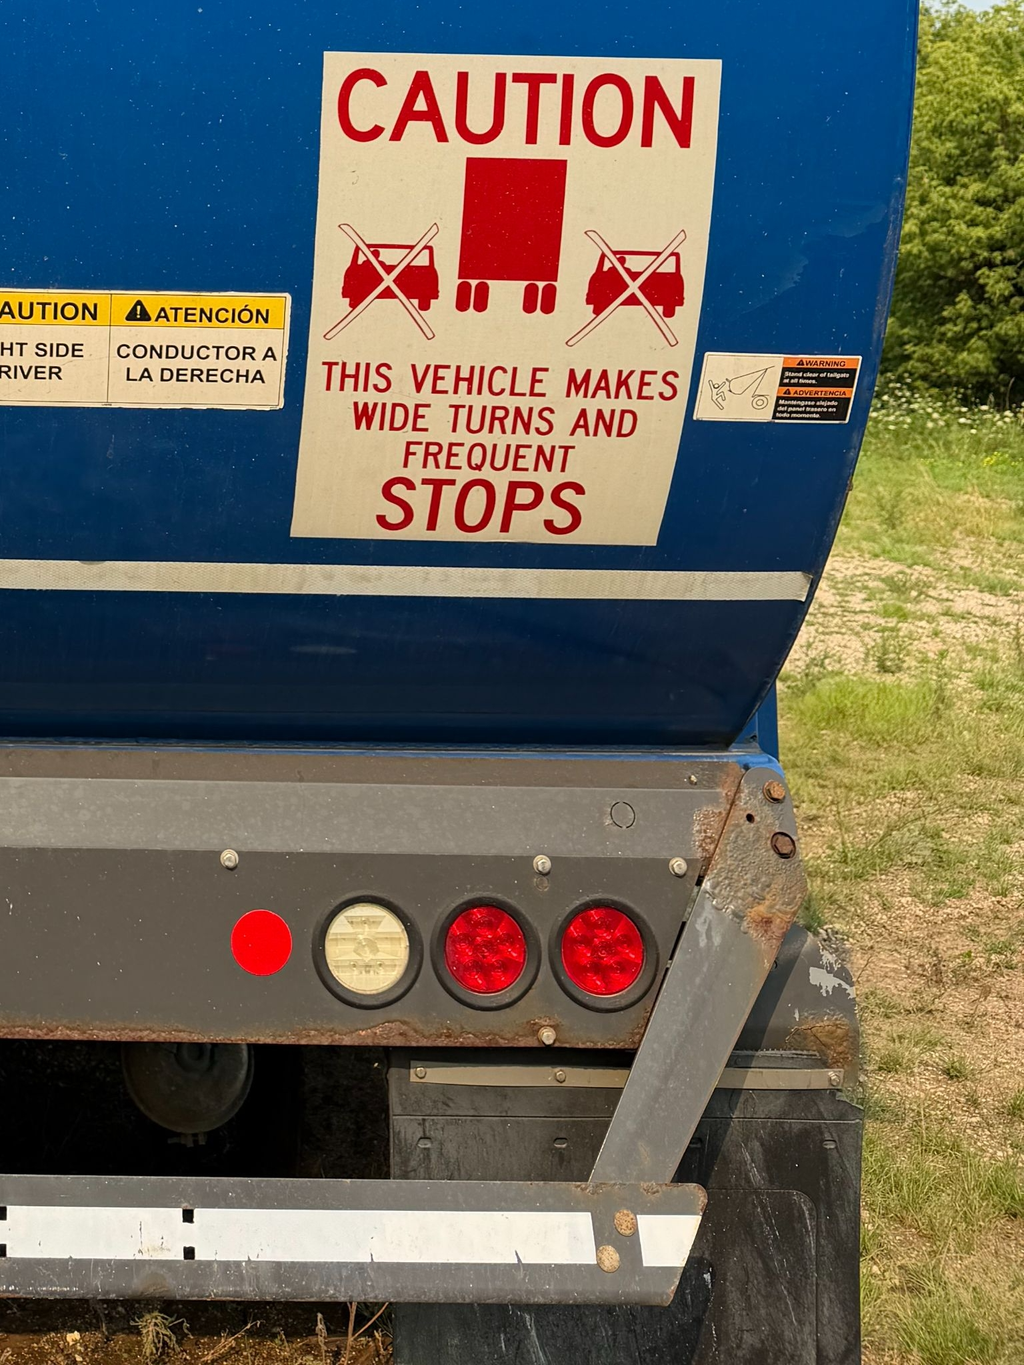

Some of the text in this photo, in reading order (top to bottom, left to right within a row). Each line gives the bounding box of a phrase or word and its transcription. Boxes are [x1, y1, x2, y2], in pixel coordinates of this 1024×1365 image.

[337, 68, 695, 149] CAUTION
[154, 304, 270, 324] ATENCIÓN
[34, 342, 84, 358] SIDE
[116, 343, 277, 362] CONDUCTOR A
[126, 367, 266, 384] LA DERECHA
[322, 362, 680, 401] THIS VEHICLE MAKES
[353, 401, 638, 438] WIDE TURNS AND
[403, 441, 576, 473] FREQUENT
[376, 477, 586, 535] STOPS
